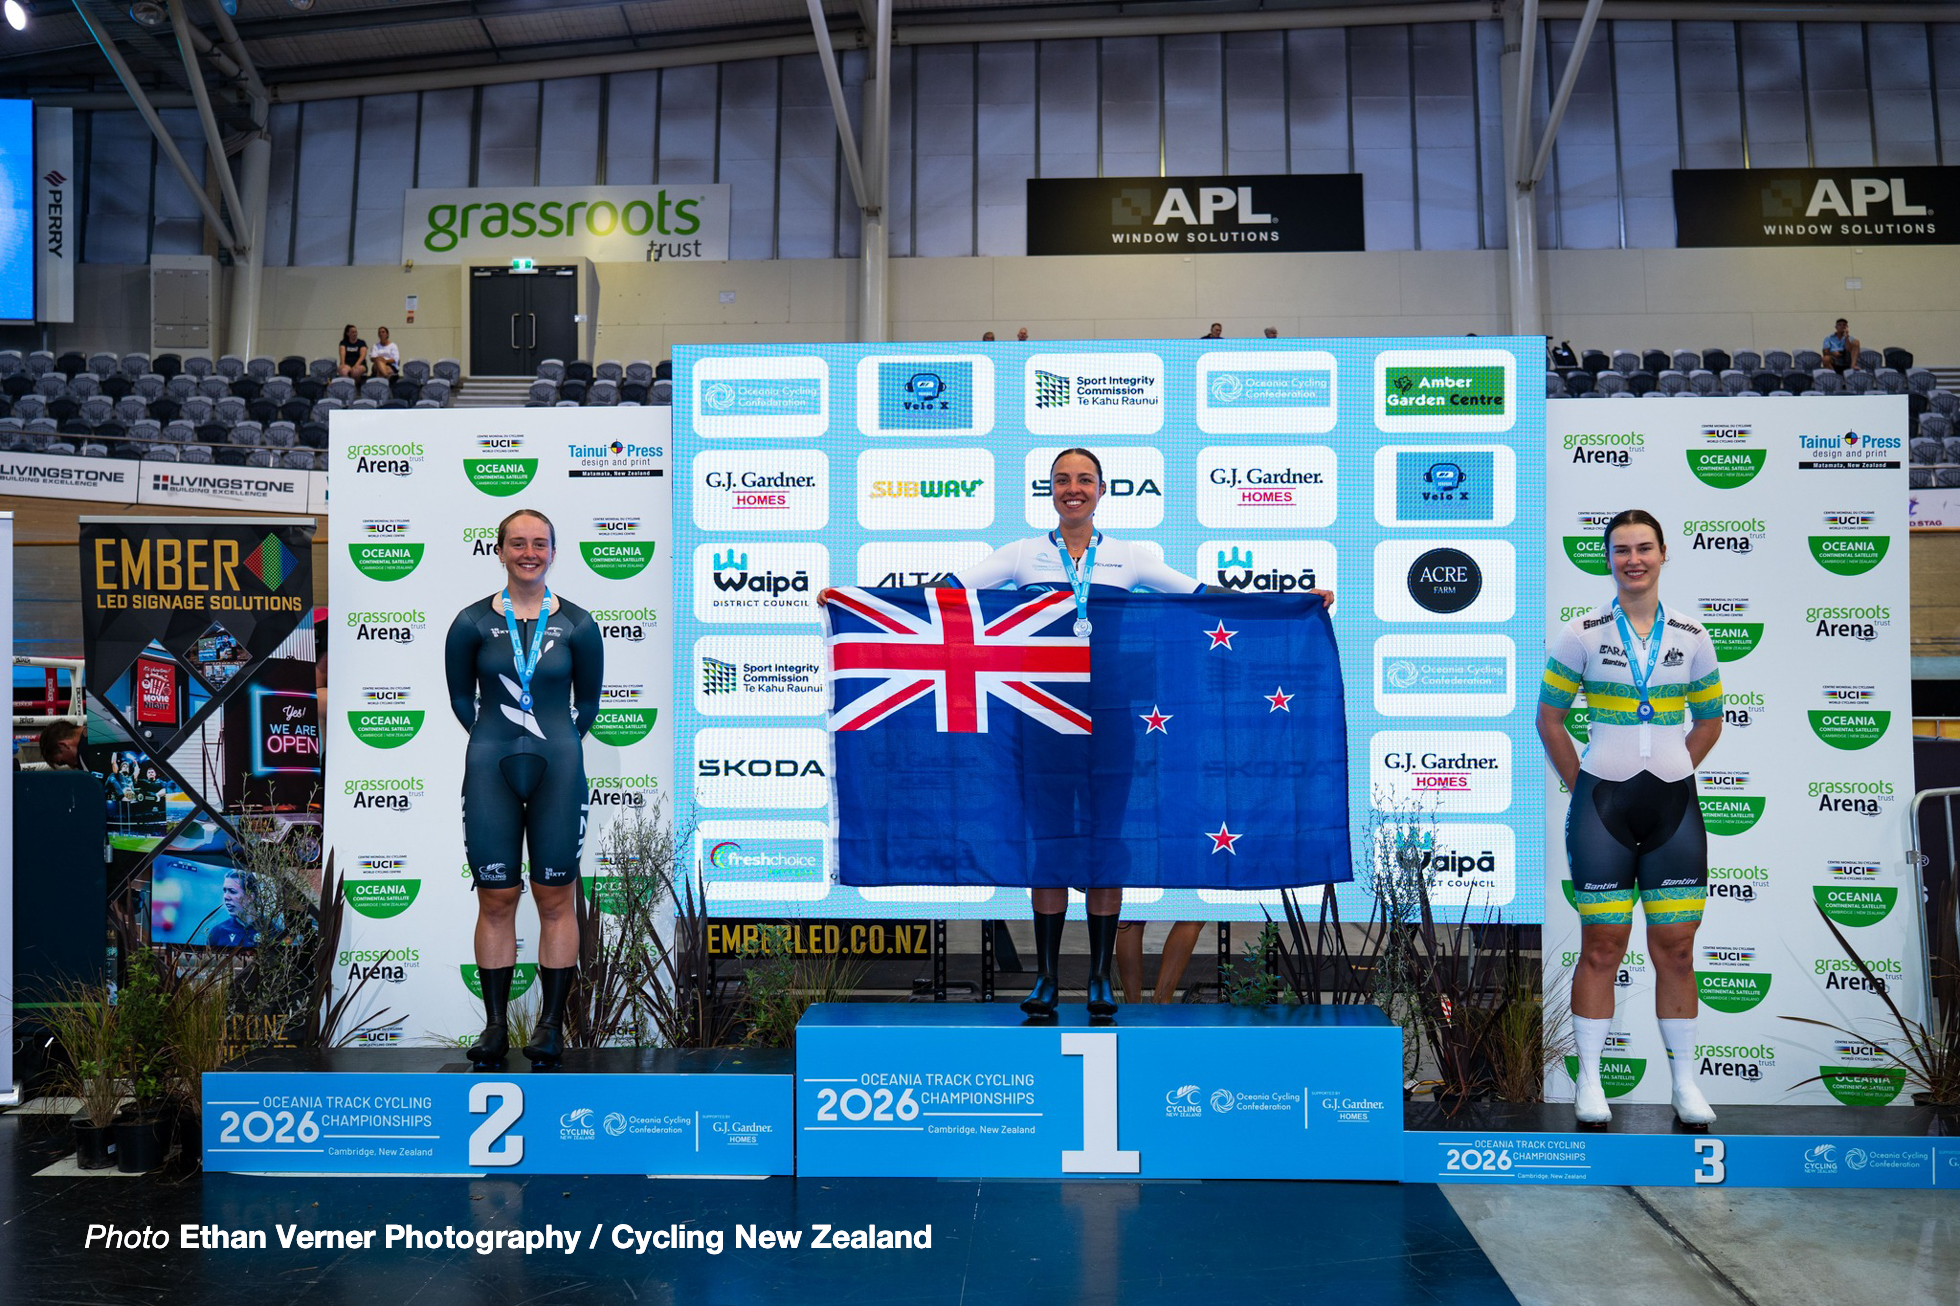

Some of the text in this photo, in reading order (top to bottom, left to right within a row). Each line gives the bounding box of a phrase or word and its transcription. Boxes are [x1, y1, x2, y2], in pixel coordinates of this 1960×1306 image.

[48, 190, 62, 258] PERRY
[424, 189, 701, 252] grassroots
[1764, 223, 1936, 235] WINDOW SOLUTIONS
[1112, 231, 1279, 243] WINDOW SOLUTIONS
[649, 240, 701, 258] trust
[1077, 376, 1154, 387] Sport Integrity
[1419, 377, 1472, 388] Amber
[1077, 386, 1144, 395] Commission
[904, 402, 949, 410] Velo X
[1078, 396, 1158, 406] Te Kahu Raunui
[1387, 394, 1502, 406] Garden Centre
[491, 439, 511, 448] UCI
[1563, 431, 1644, 450] grassroots
[1799, 435, 1901, 448] Tainui Press
[348, 442, 423, 459] grassroots
[569, 444, 663, 457] Tainui Press
[1573, 447, 1629, 463] Arena
[357, 457, 409, 473] Arena
[582, 458, 650, 467] design and print
[0, 465, 124, 482] LIVINGSTONE
[477, 464, 524, 474] OCEANIA
[42, 479, 97, 487] EXCELLENCE
[170, 475, 294, 492] LIVINGSTONE
[706, 472, 736, 491] G.J.
[1210, 468, 1241, 487] G.J.
[170, 486, 267, 497] BUILDING EXCELLENCE
[869, 479, 984, 499] SUBWAY
[737, 495, 785, 505] HOMES
[1242, 492, 1292, 501] HOMES
[1822, 542, 1874, 550] OCEANIA
[95, 539, 240, 591] EMBER
[1420, 567, 1467, 583] ACRE
[714, 571, 808, 597] Waipā
[97, 595, 302, 611] LED SIGNAGE SOLUTIONS
[348, 609, 425, 627] grassroots
[357, 624, 411, 640] Arena
[1667, 619, 1702, 635] Santini
[1602, 658, 1627, 667] Santini
[743, 664, 819, 675] Sport Integrity
[1467, 665, 1503, 675] Cycling
[743, 674, 808, 682] Commission
[1422, 676, 1491, 685] Confederation
[744, 684, 822, 692] Te Kahu Raunui
[282, 705, 306, 720] Yes!
[270, 724, 316, 736] WE ARE
[267, 736, 318, 754] OPEN
[1385, 753, 1415, 772] G.J.
[1417, 777, 1467, 786] HOMES
[1808, 780, 1893, 797] grassroots
[1819, 794, 1878, 811] Arena
[728, 851, 815, 866] freshchoice
[1584, 882, 1618, 890] Santini
[1661, 878, 1698, 886] Santini
[861, 1073, 1034, 1086] OCEANIA TRACK CYCLING
[263, 1096, 431, 1109] OCEANIA TRACK CYCLING
[921, 1092, 1034, 1104] CHAMPIONSHIPS
[1061, 1033, 1139, 1172] 1
[1237, 1093, 1299, 1102] Oceania Cycling
[817, 1088, 919, 1121] 2026
[1322, 1099, 1339, 1111] G.J.
[322, 1115, 431, 1127] CHAMPIONSHIPS
[468, 1082, 524, 1166] 2
[629, 1116, 691, 1125] Oceania Cycling
[220, 1111, 320, 1143] 2026
[713, 1122, 730, 1134] G.J.
[928, 1125, 1035, 1135] Cambridge, New Zealand
[1475, 1140, 1585, 1149] OCEANIA TRACK CYCLING
[328, 1147, 432, 1157] Cambridge, New Zealand
[1513, 1152, 1585, 1161] CHAMPIONSHIPS
[1902, 1152, 1928, 1160] Cycling
[1447, 1150, 1512, 1171] 2026
[1695, 1139, 1724, 1184] 3
